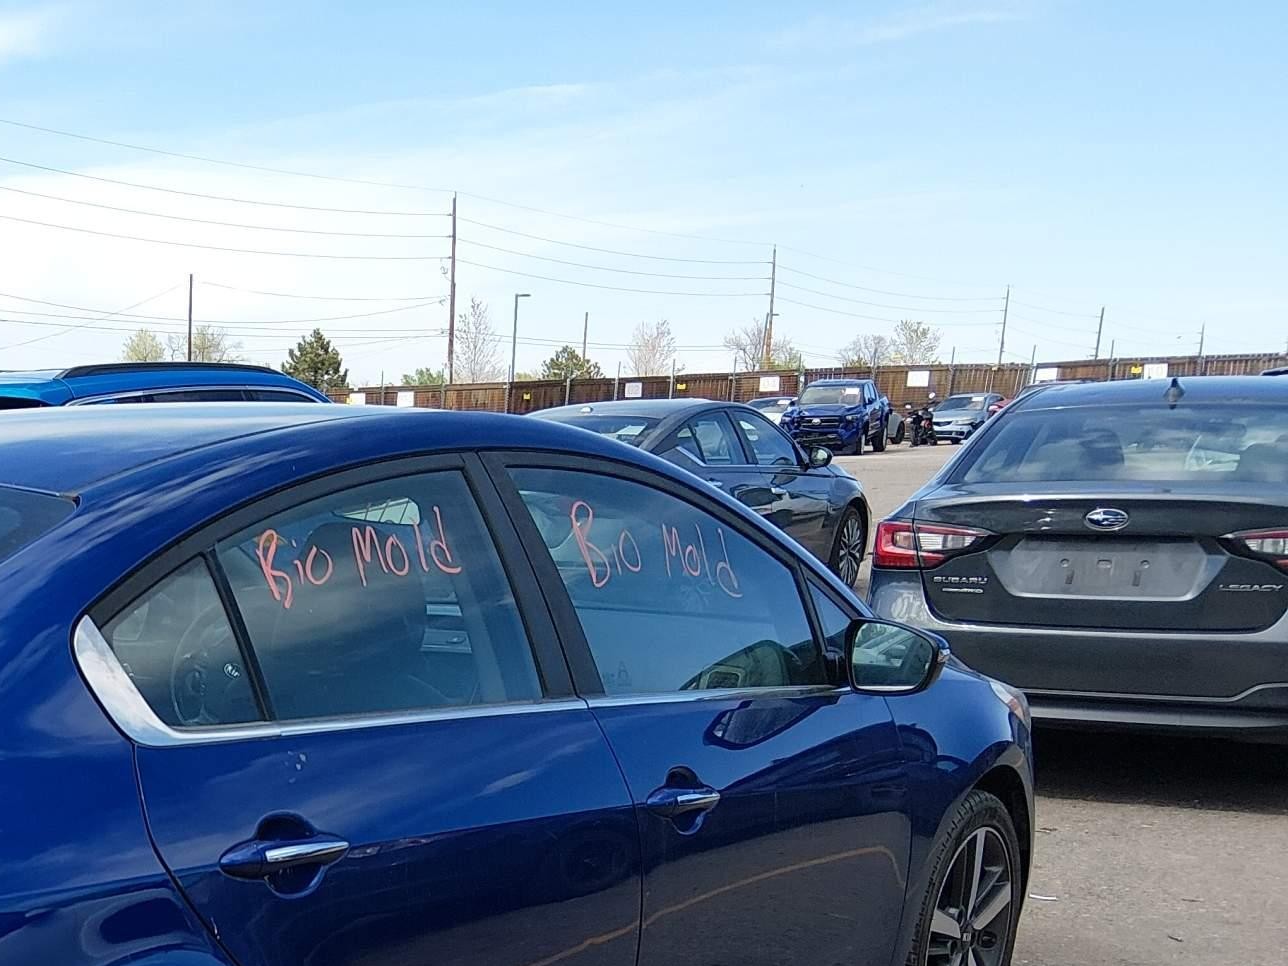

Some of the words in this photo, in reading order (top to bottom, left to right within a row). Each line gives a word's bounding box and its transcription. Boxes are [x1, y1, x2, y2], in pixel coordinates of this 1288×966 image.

[571, 500, 642, 588] Bio
[256, 528, 333, 609] Bio
[933, 576, 989, 584] SUBARU
[1218, 584, 1284, 592] LEGACY
